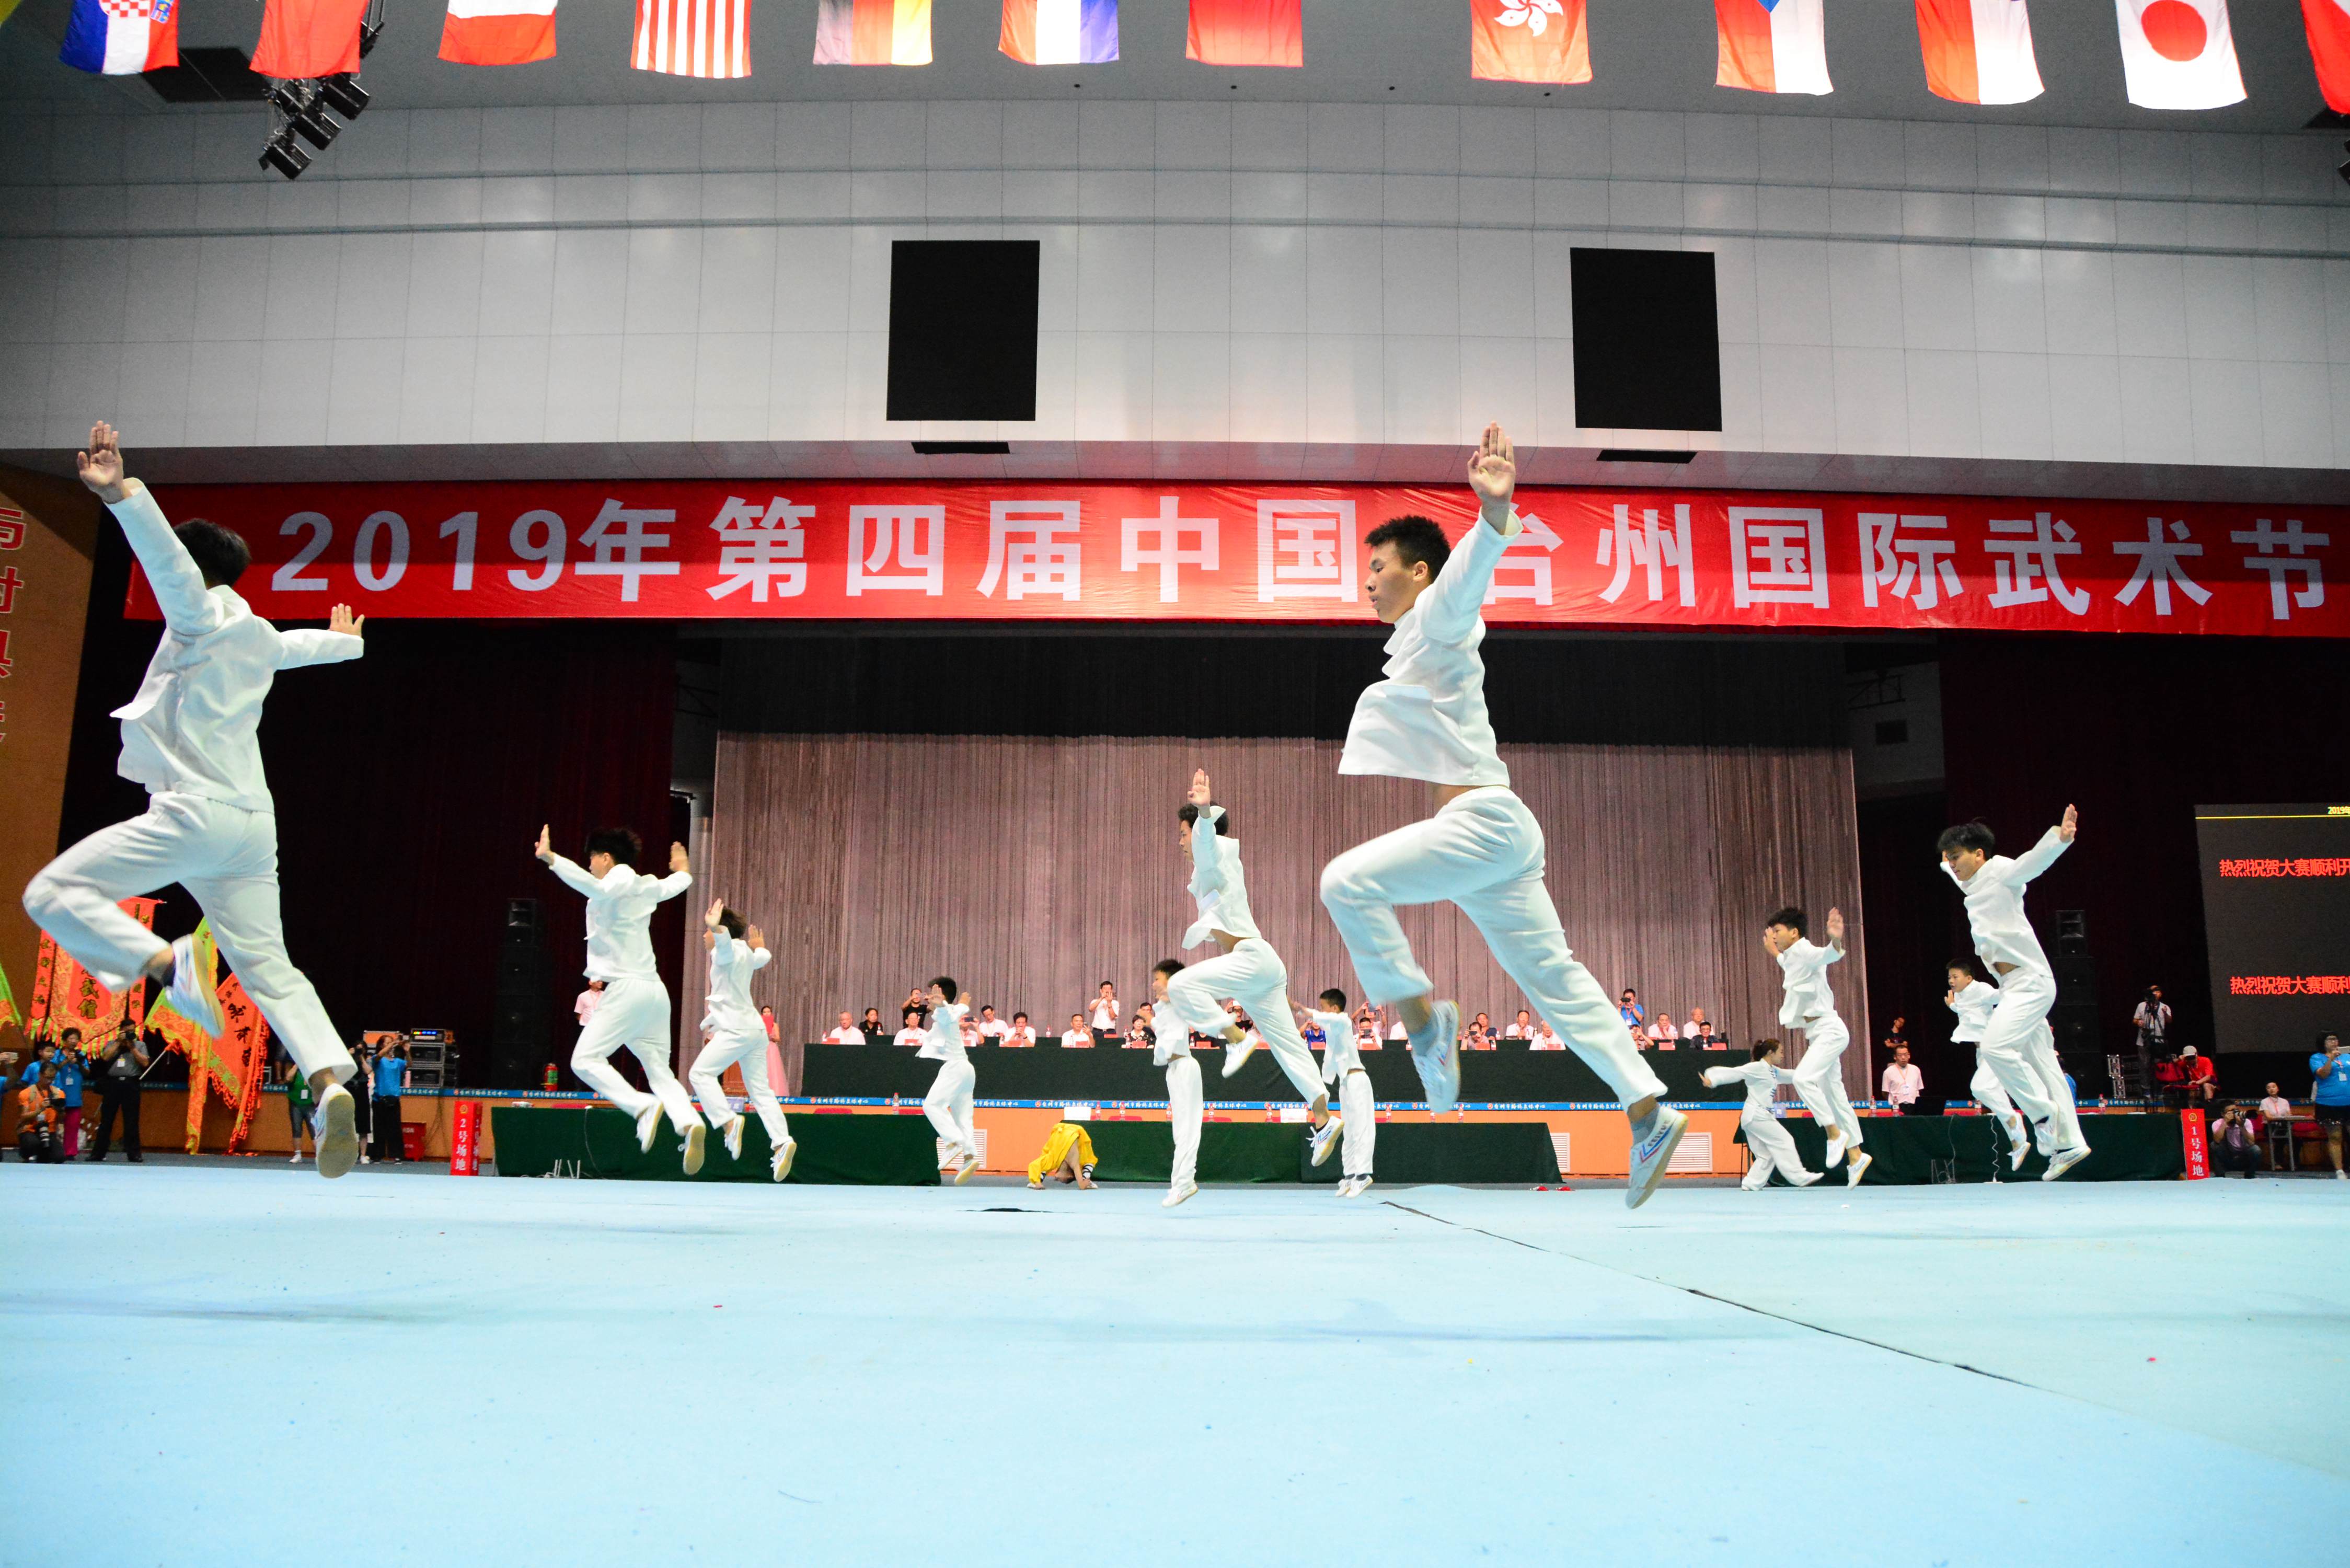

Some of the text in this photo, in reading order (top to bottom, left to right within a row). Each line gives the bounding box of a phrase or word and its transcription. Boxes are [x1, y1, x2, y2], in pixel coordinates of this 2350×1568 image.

[2219, 858, 2350, 877] 热烈祝贺大赛顺利开
[2230, 976, 2350, 995] 热烈祝贺大赛顺利
[455, 1118, 468, 1171] 2号场地
[2191, 1126, 2204, 1176] 1号场地
